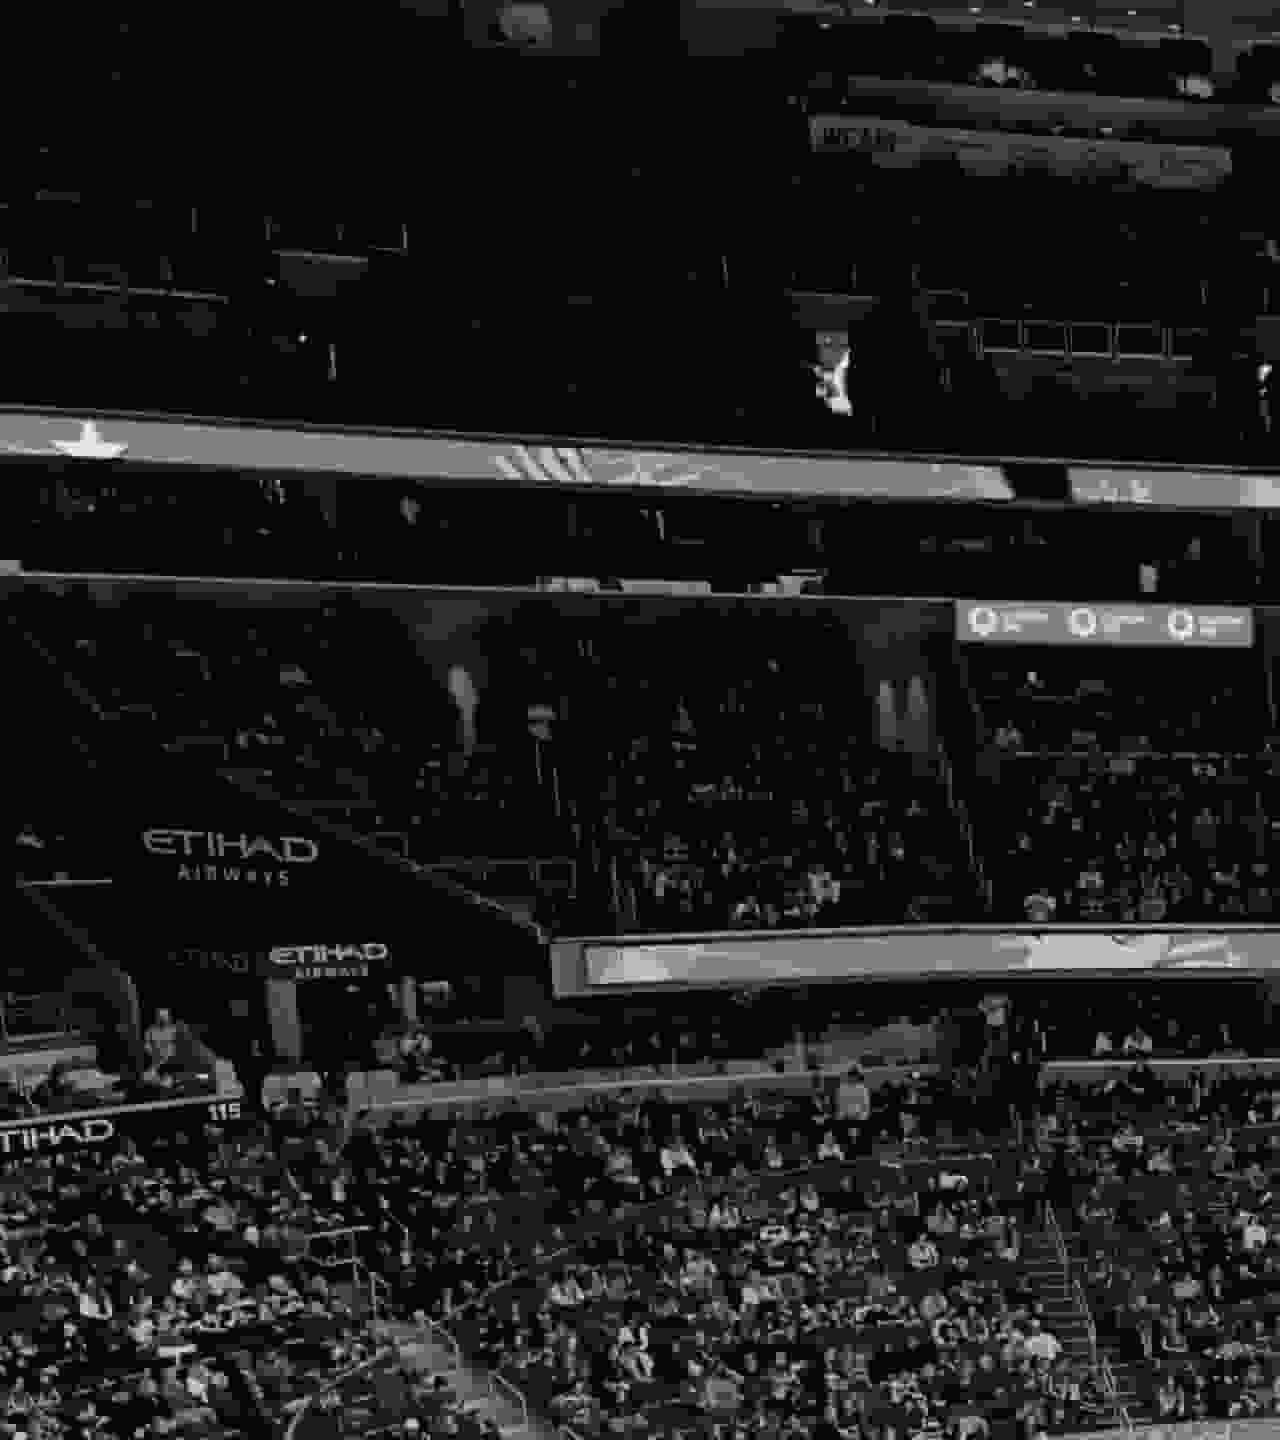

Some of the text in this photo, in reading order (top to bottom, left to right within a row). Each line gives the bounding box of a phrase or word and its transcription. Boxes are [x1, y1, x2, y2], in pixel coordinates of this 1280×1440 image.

[144, 826, 320, 864] ETIHAD
[268, 942, 392, 967] ETIHAD
[0, 1119, 115, 1153] TIHAD
